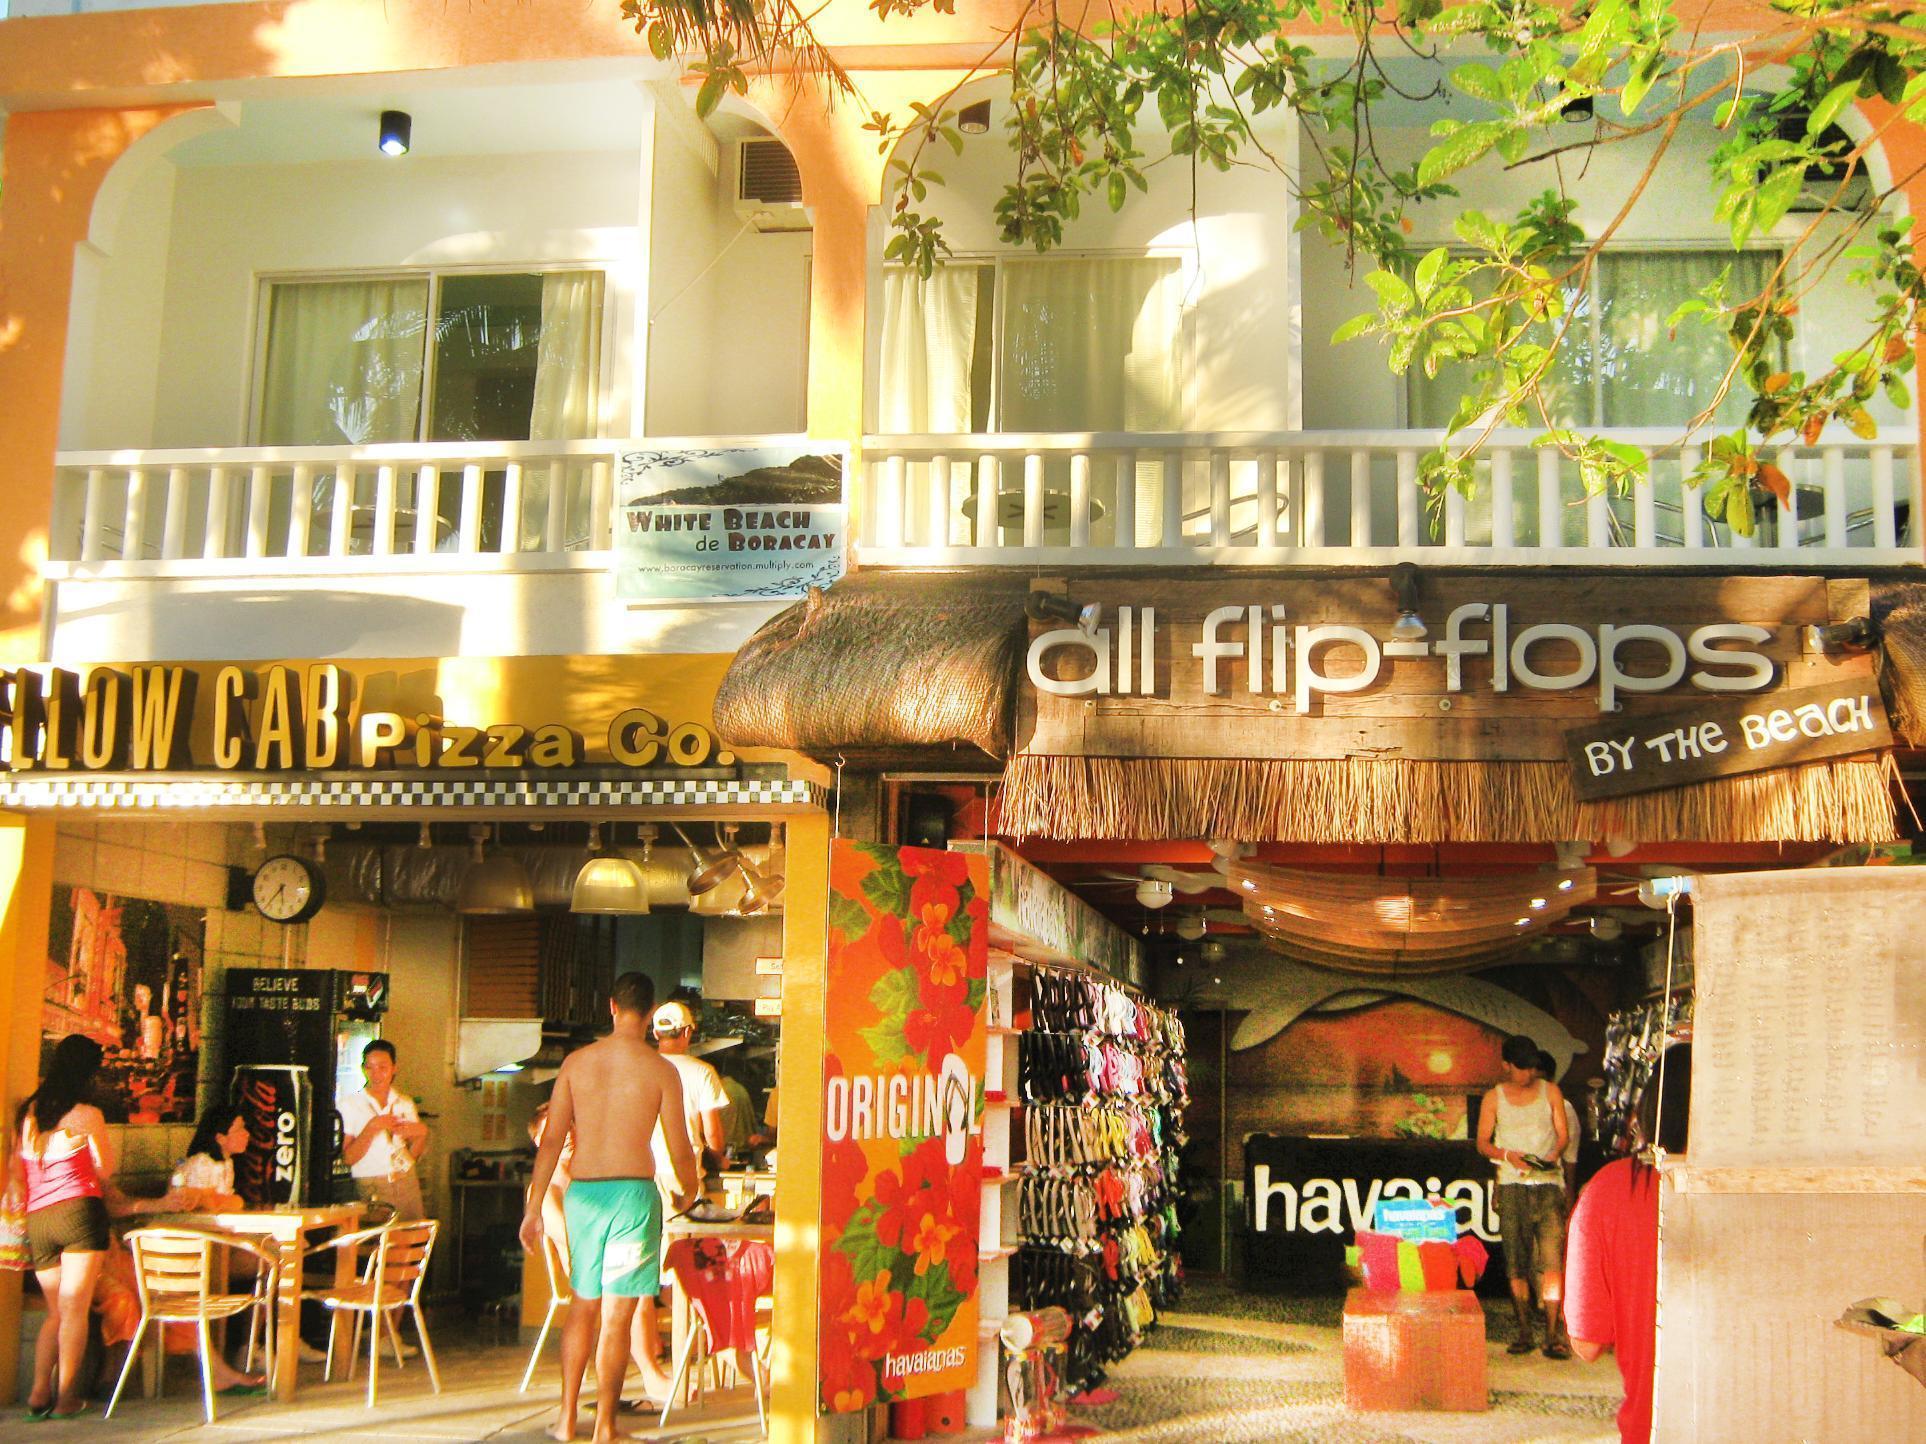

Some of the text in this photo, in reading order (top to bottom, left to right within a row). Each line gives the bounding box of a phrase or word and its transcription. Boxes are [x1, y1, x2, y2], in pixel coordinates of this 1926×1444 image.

[626, 508, 811, 533] WHITE BEACH
[695, 532, 836, 552] de BORACAY
[638, 560, 815, 574] www.boracayreservation.multiply.com
[1026, 603, 1775, 713] all flip-flops
[0, 664, 736, 770] LLOW CAB Pizza Co.
[1584, 735, 1635, 777] BY
[252, 977, 299, 992] BELIEVE
[275, 1111, 296, 1182] zero
[885, 1346, 967, 1378] havaianas
